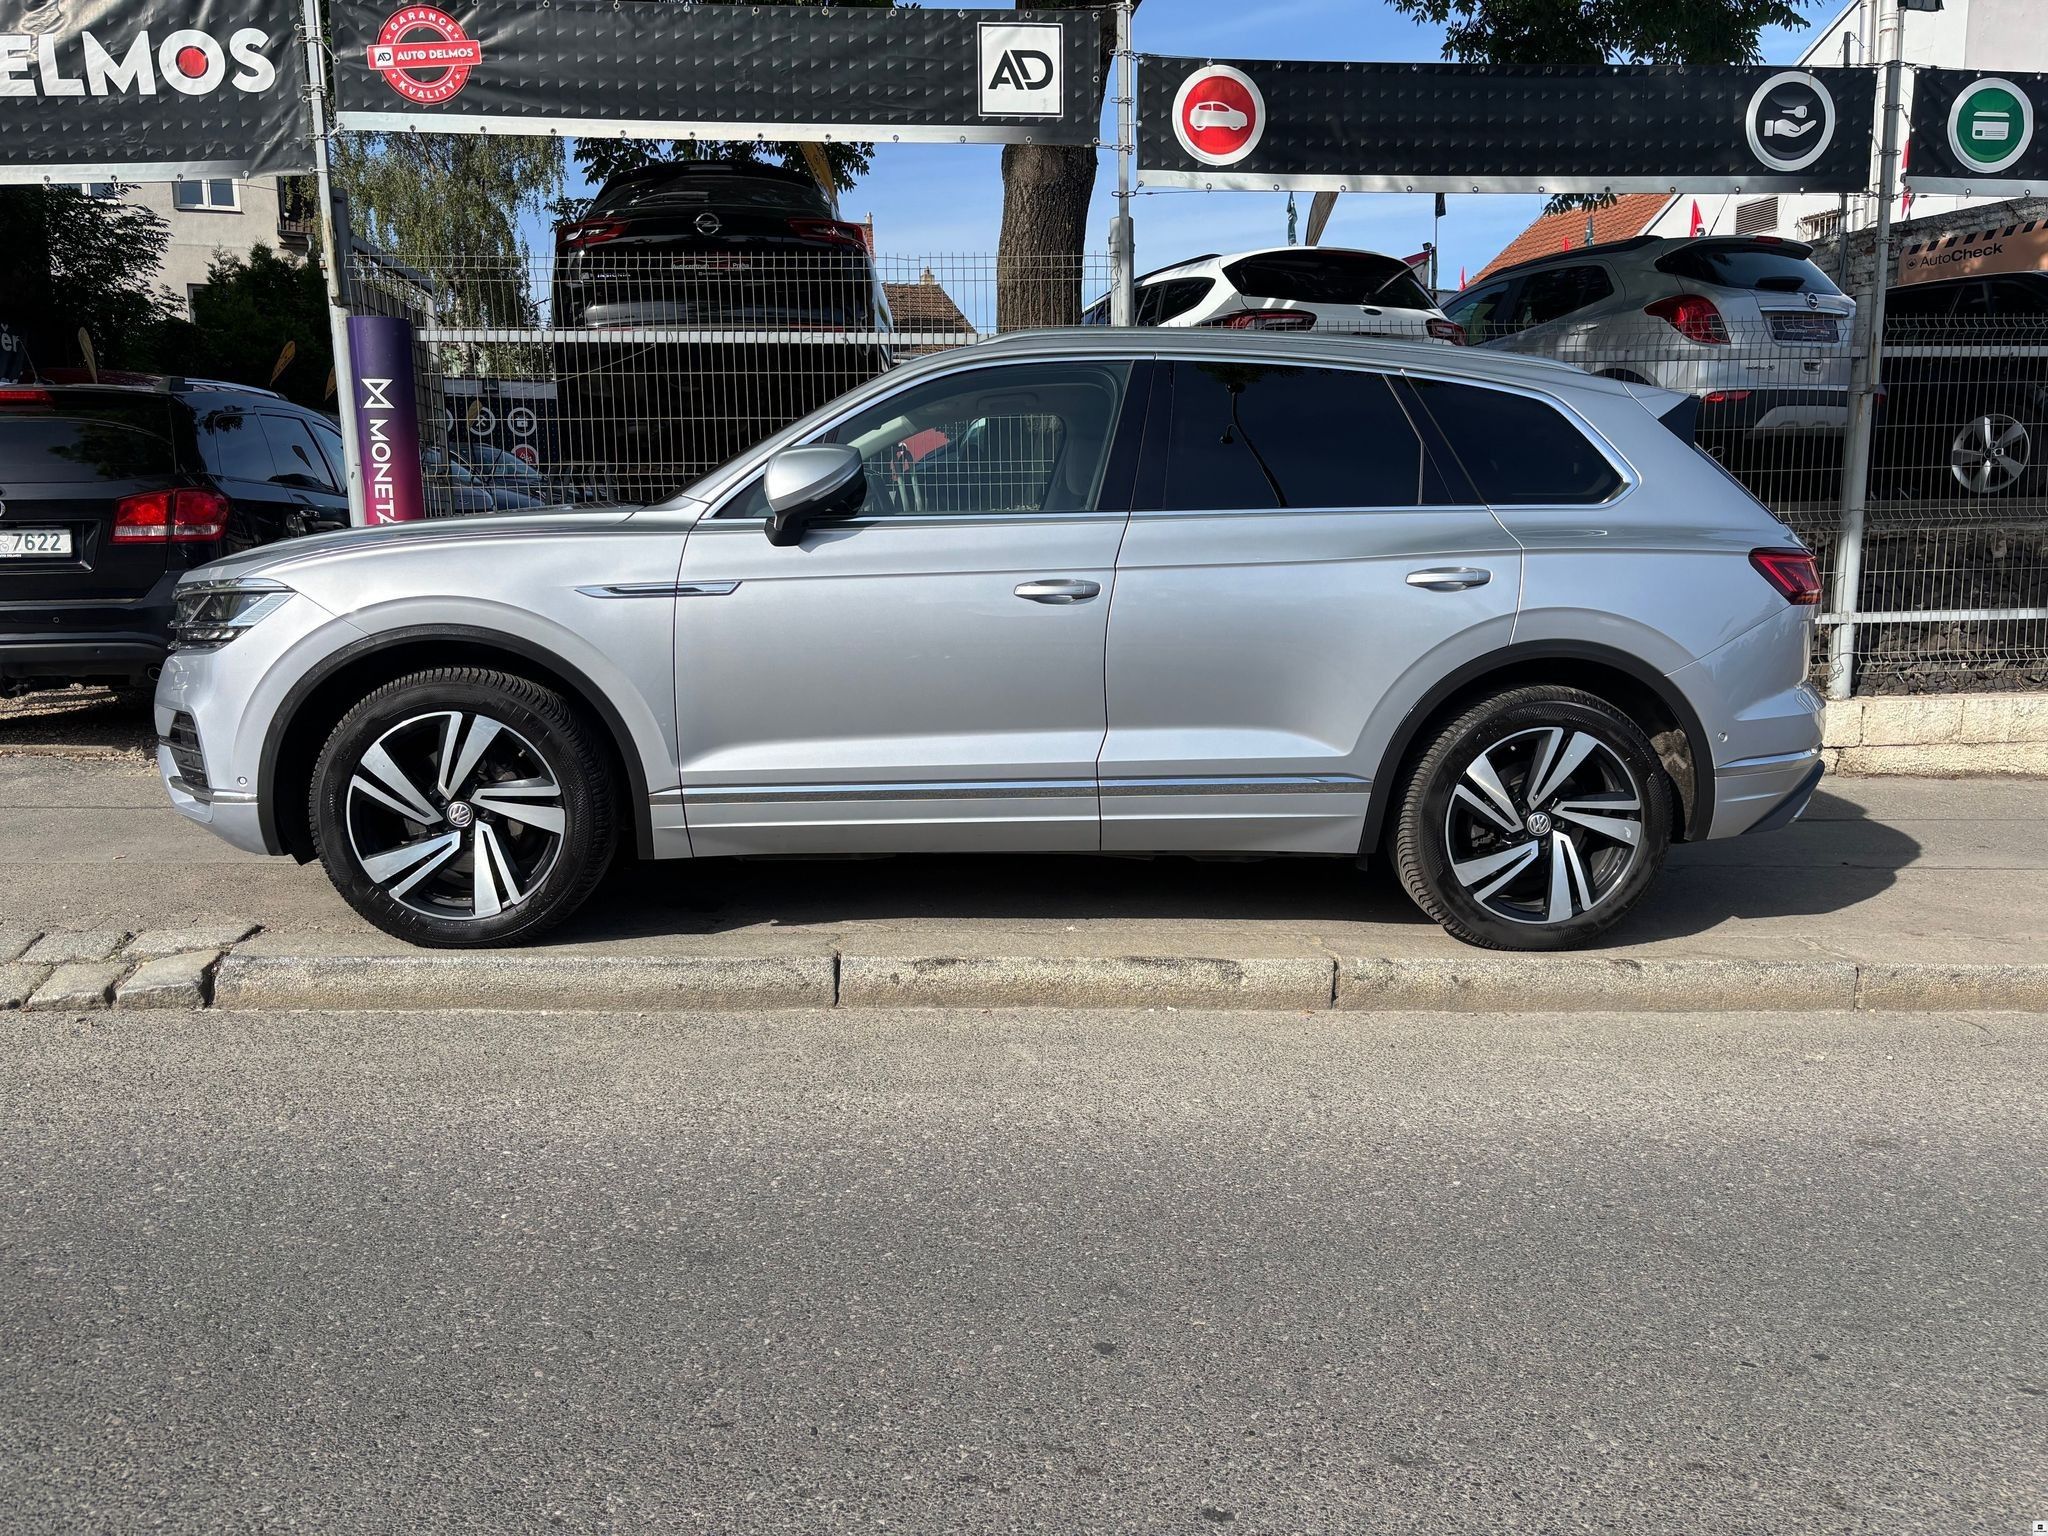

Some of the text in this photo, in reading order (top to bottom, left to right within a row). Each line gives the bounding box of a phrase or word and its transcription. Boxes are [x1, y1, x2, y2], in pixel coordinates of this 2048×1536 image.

[390, 11, 455, 32] GARANCE
[0, 28, 276, 96] ELMOS
[397, 50, 426, 60] AUTO
[429, 48, 473, 59] DELMOS
[988, 49, 1054, 90] AD
[398, 80, 455, 98] KVALITY
[1920, 243, 2003, 268] AutoCheck
[12, 533, 61, 551] 7622
